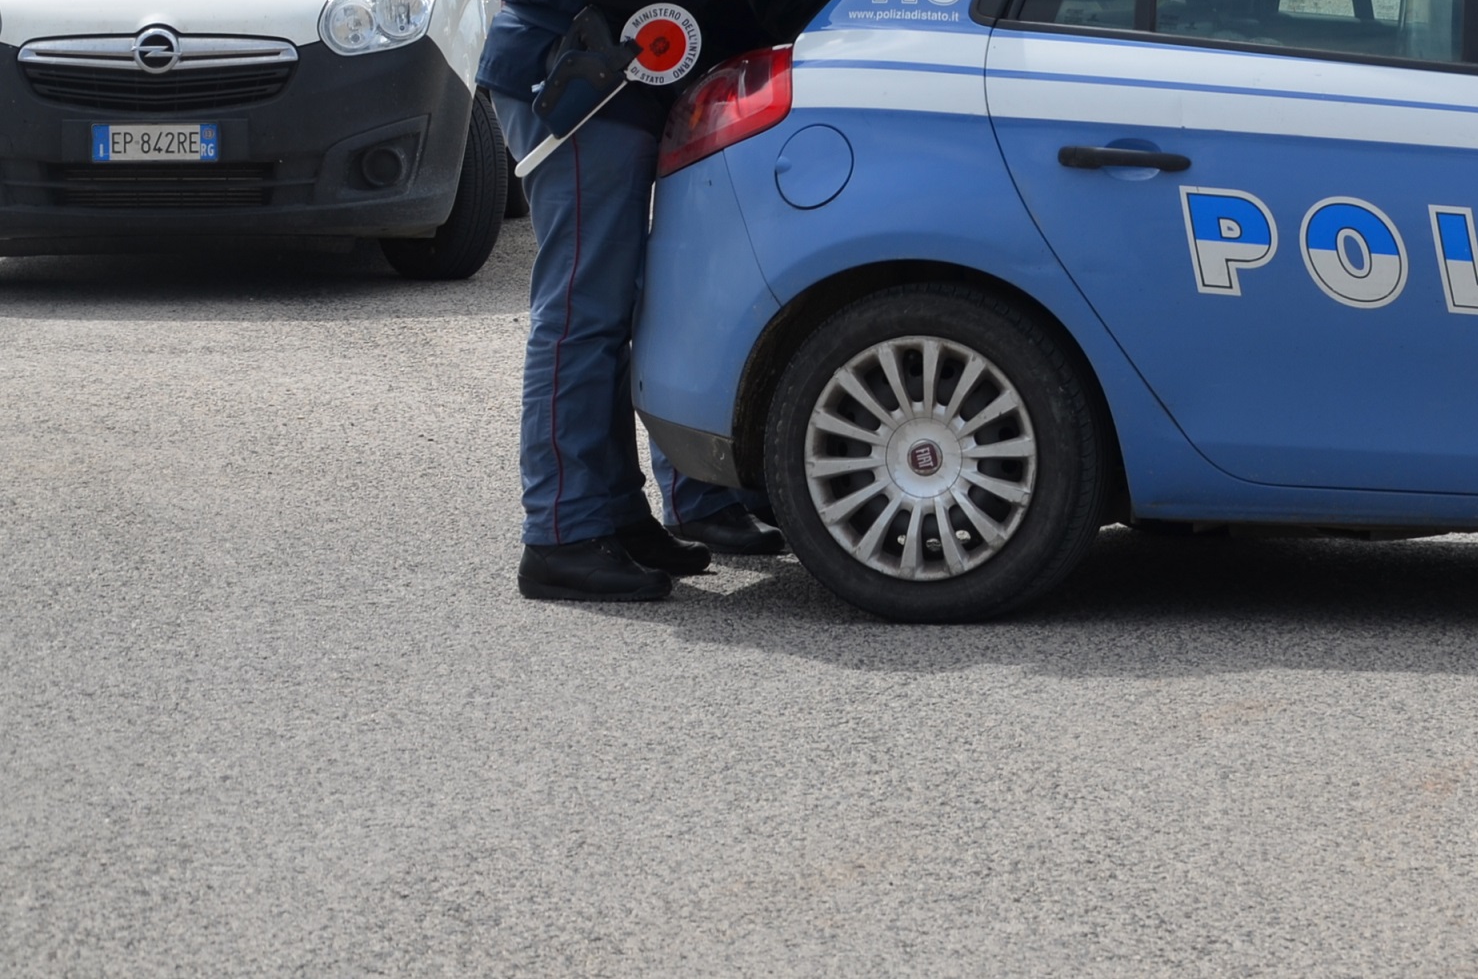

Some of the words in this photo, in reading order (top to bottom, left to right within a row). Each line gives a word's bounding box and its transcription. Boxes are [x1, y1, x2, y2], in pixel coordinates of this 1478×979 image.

[632, 8, 681, 28] MINISTERO
[848, 9, 959, 22] www.poliziadistato.it
[630, 66, 640, 76] DI
[640, 73, 665, 84] STATO
[200, 143, 214, 157] RG
[915, 446, 934, 468] FIAT
